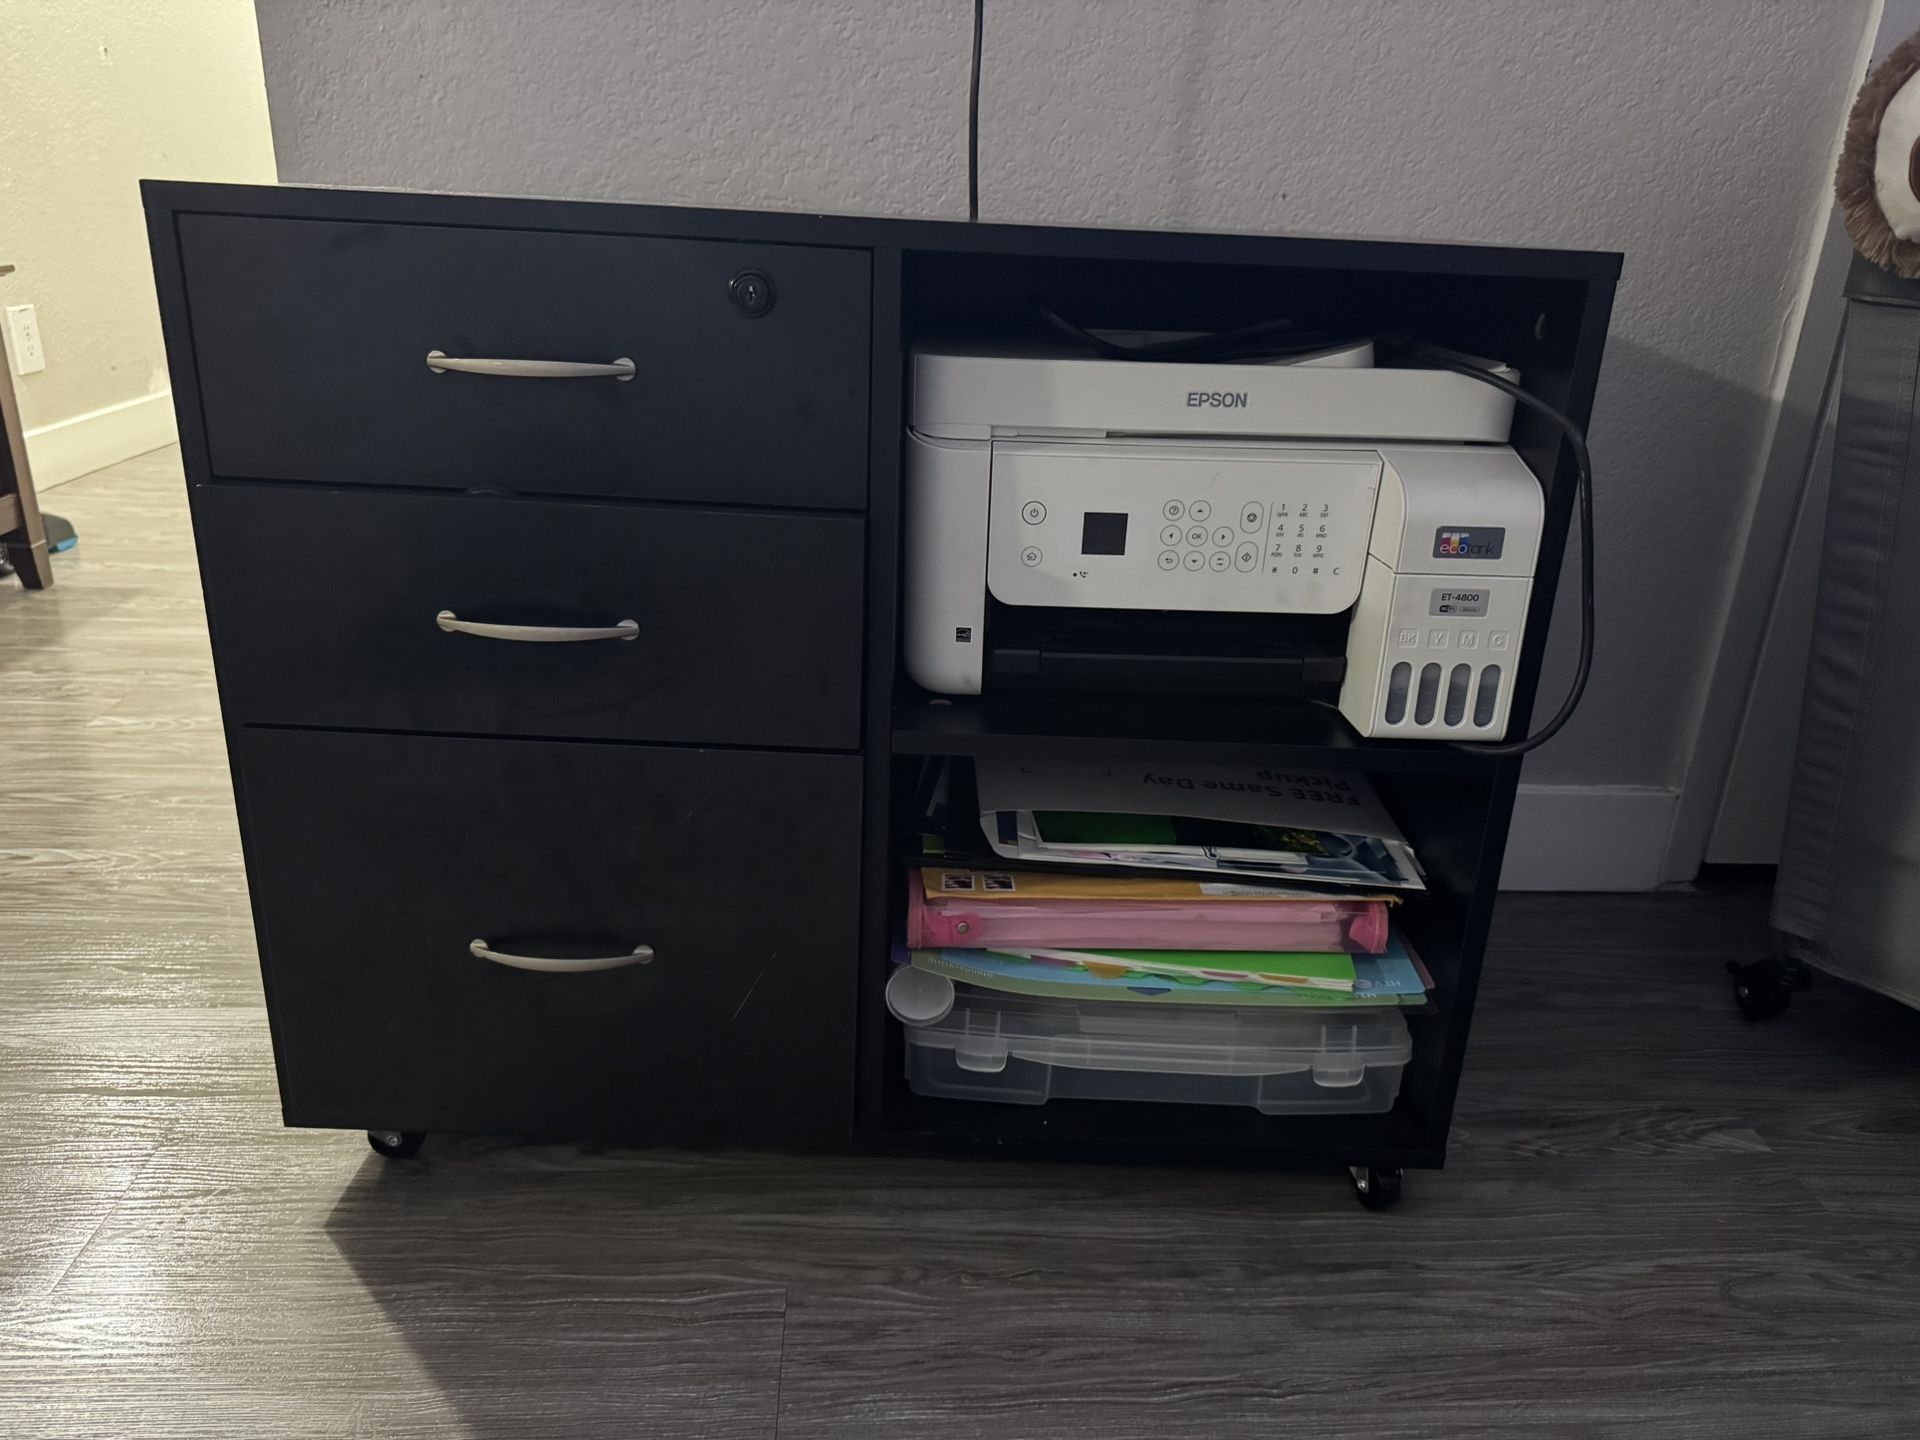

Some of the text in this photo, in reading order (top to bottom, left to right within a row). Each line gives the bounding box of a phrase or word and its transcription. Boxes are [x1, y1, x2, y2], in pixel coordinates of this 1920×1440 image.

[1187, 392, 1248, 408] EPSON
[1282, 503, 1329, 512] 1 2 3
[1277, 523, 1326, 532] 4 5 6
[1275, 543, 1323, 553] 7 8 9
[1332, 567, 1340, 575] C
[1441, 593, 1480, 602] ET-4800
[1400, 633, 1416, 644] BK
[1435, 633, 1445, 644] Y
[1143, 773, 1361, 805] FREE Same Day
